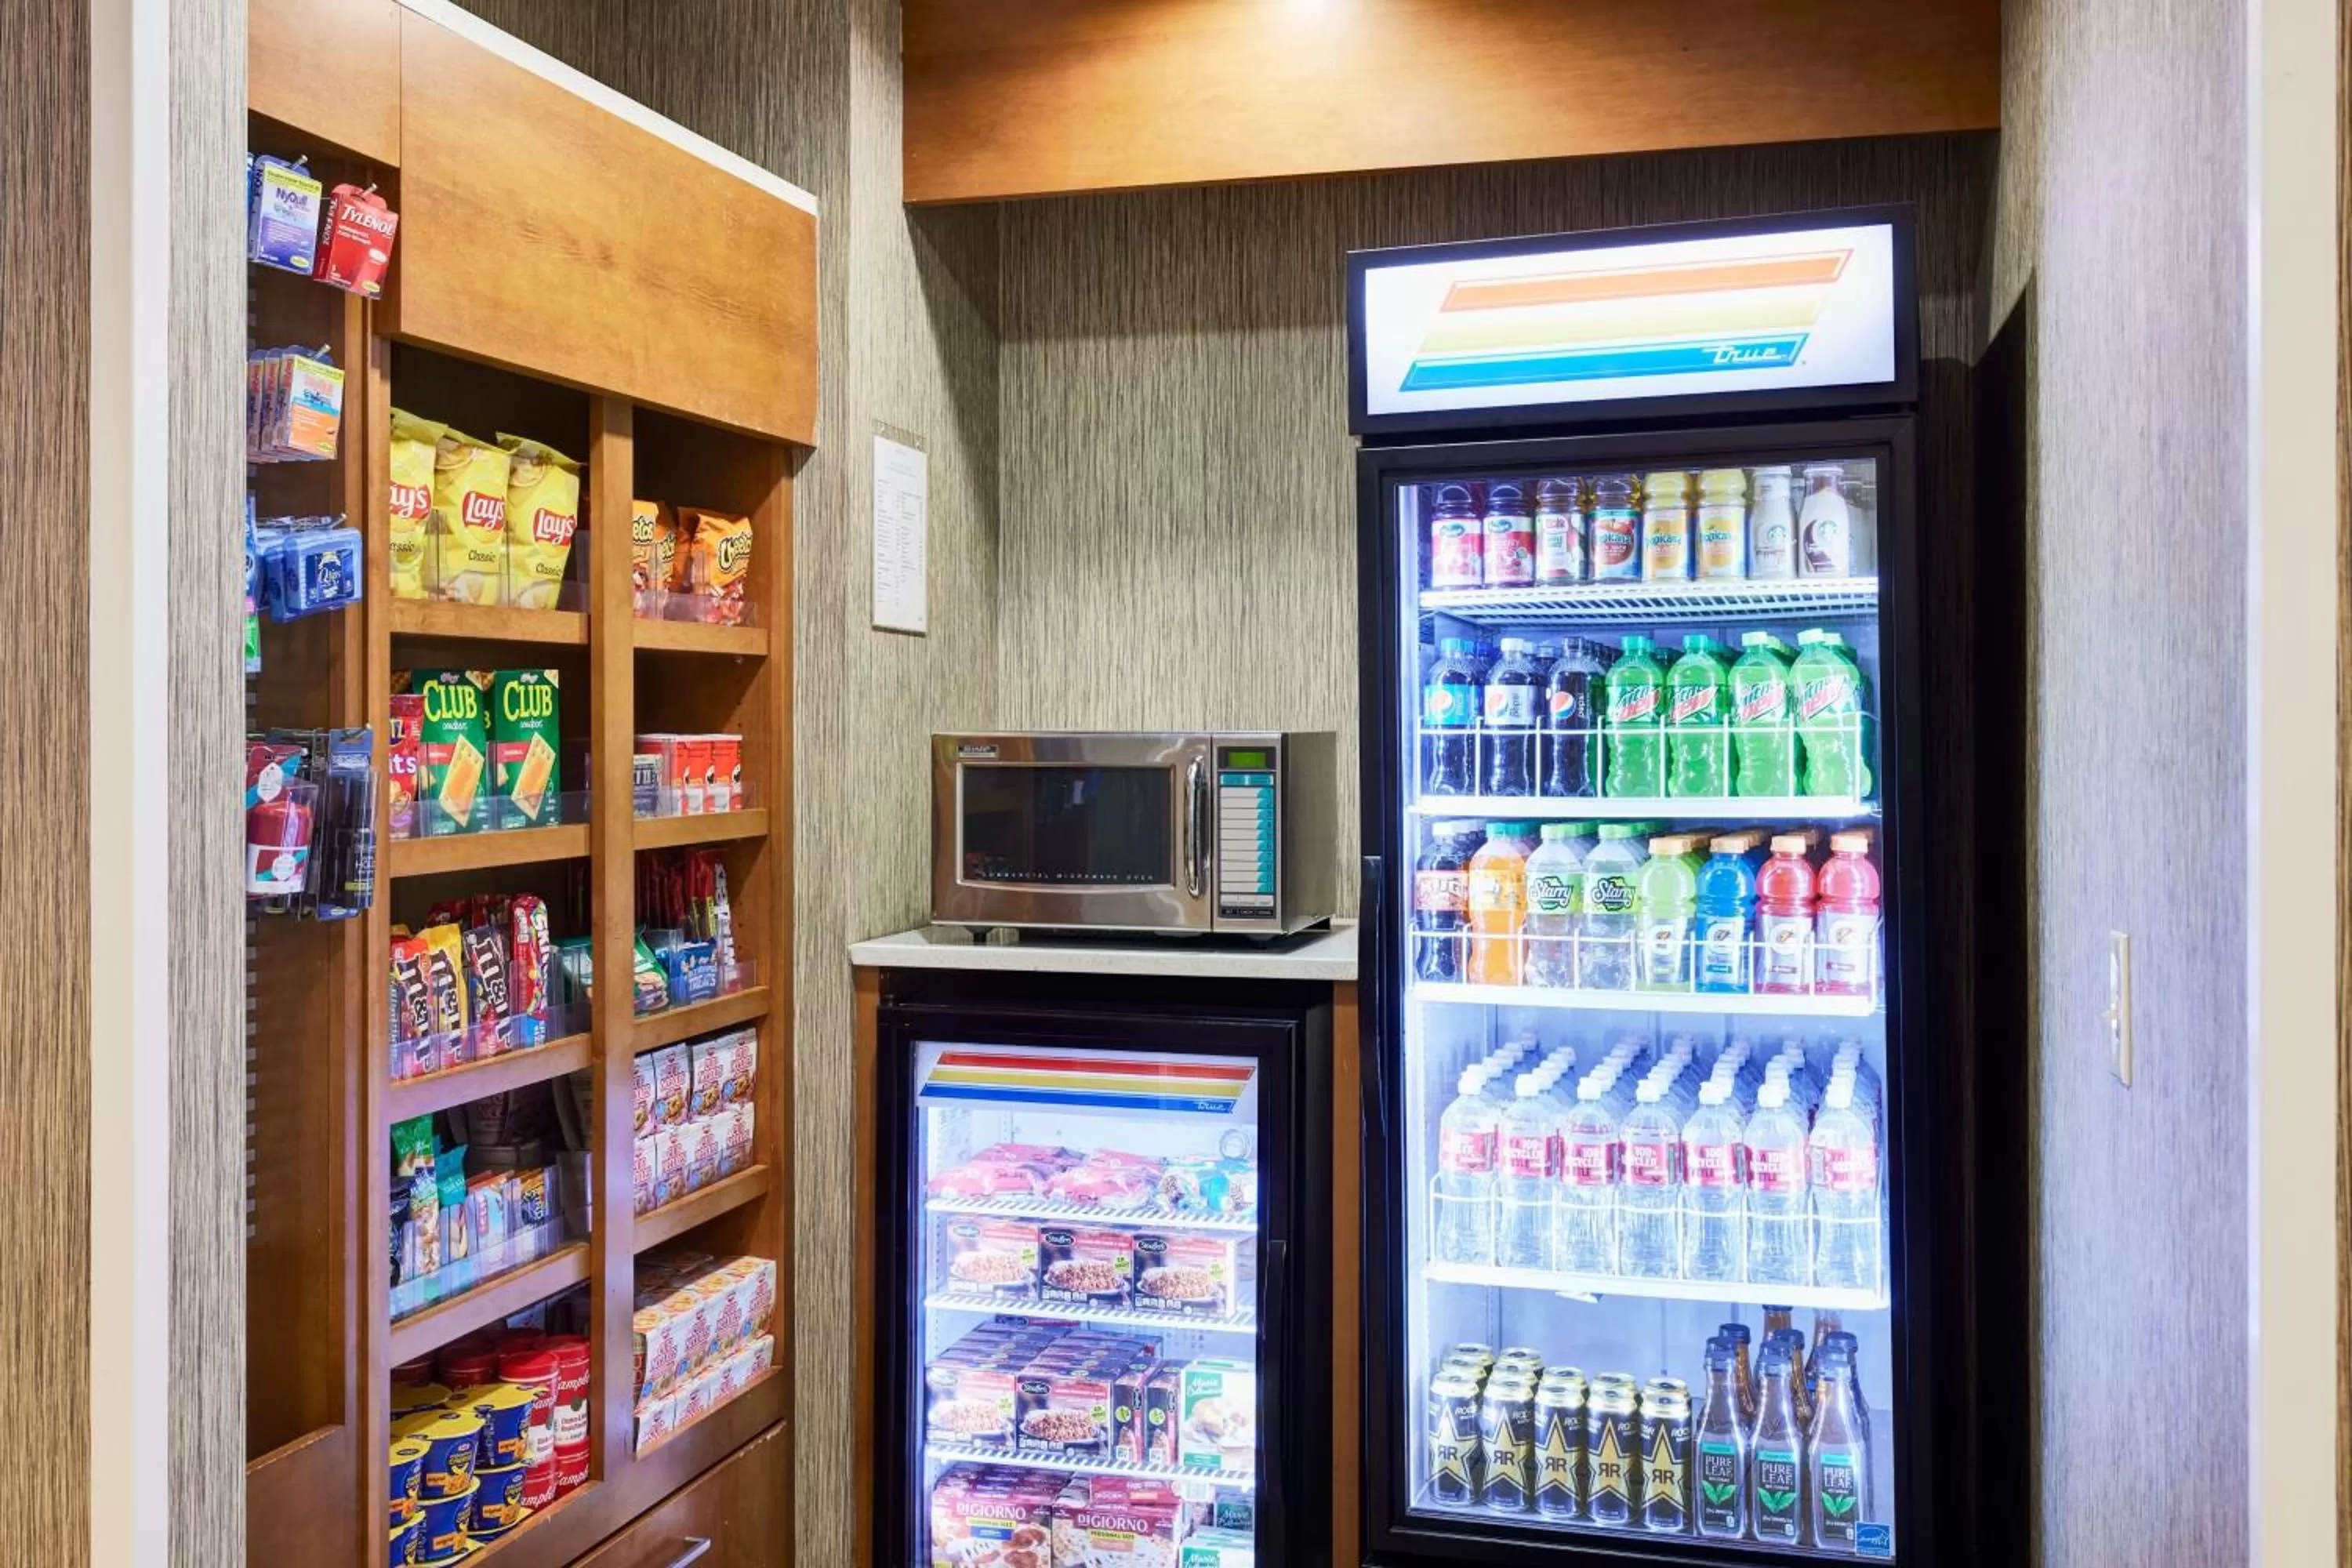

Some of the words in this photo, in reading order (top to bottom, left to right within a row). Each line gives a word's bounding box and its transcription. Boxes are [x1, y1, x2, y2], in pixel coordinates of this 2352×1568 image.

[341, 205, 394, 234] TYLENOL
[1700, 344, 1782, 364] True
[390, 484, 428, 518] ay's
[535, 511, 575, 544] Lay's
[468, 550, 496, 563] Classic
[423, 680, 477, 722] CLUB
[503, 681, 553, 722] CLUB
[1530, 879, 1573, 908] Starry
[1592, 879, 1635, 908] Starry
[1705, 1455, 1733, 1467] PURE
[1705, 1465, 1732, 1476] LEAF
[1762, 1462, 1793, 1475] PURE
[1762, 1473, 1793, 1486] LEAF
[1823, 1467, 1851, 1478] PURE
[1824, 1477, 1851, 1488] LEAF
